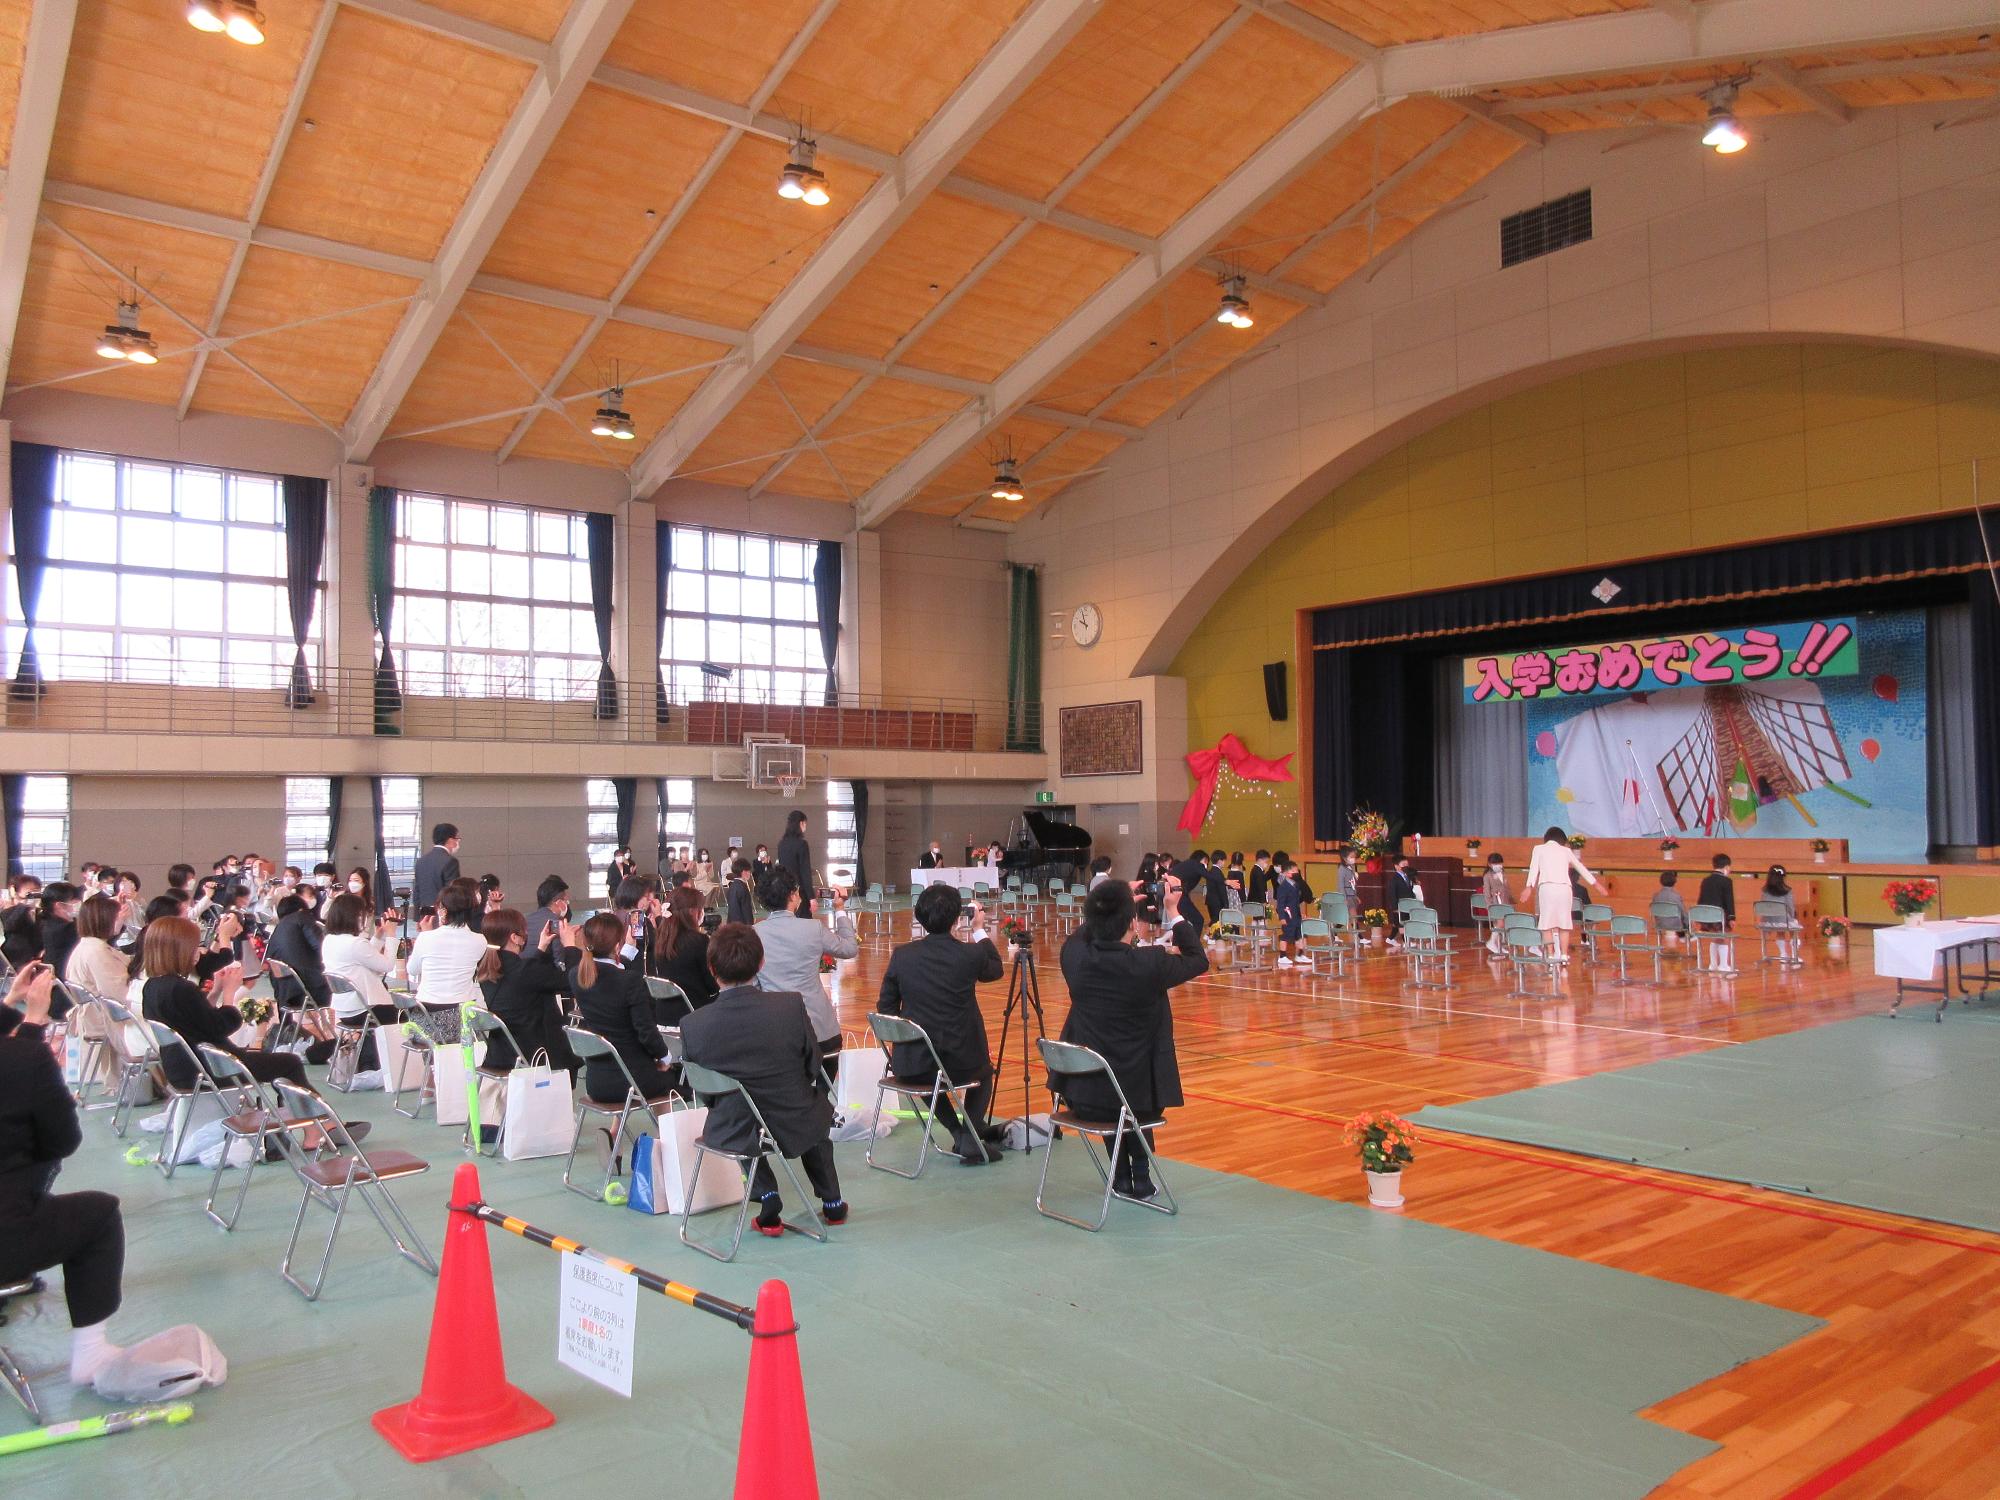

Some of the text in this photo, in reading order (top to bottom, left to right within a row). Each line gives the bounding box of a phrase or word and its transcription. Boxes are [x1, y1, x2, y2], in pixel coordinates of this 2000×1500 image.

[1472, 621, 1853, 702] 入学おめでとう!!
